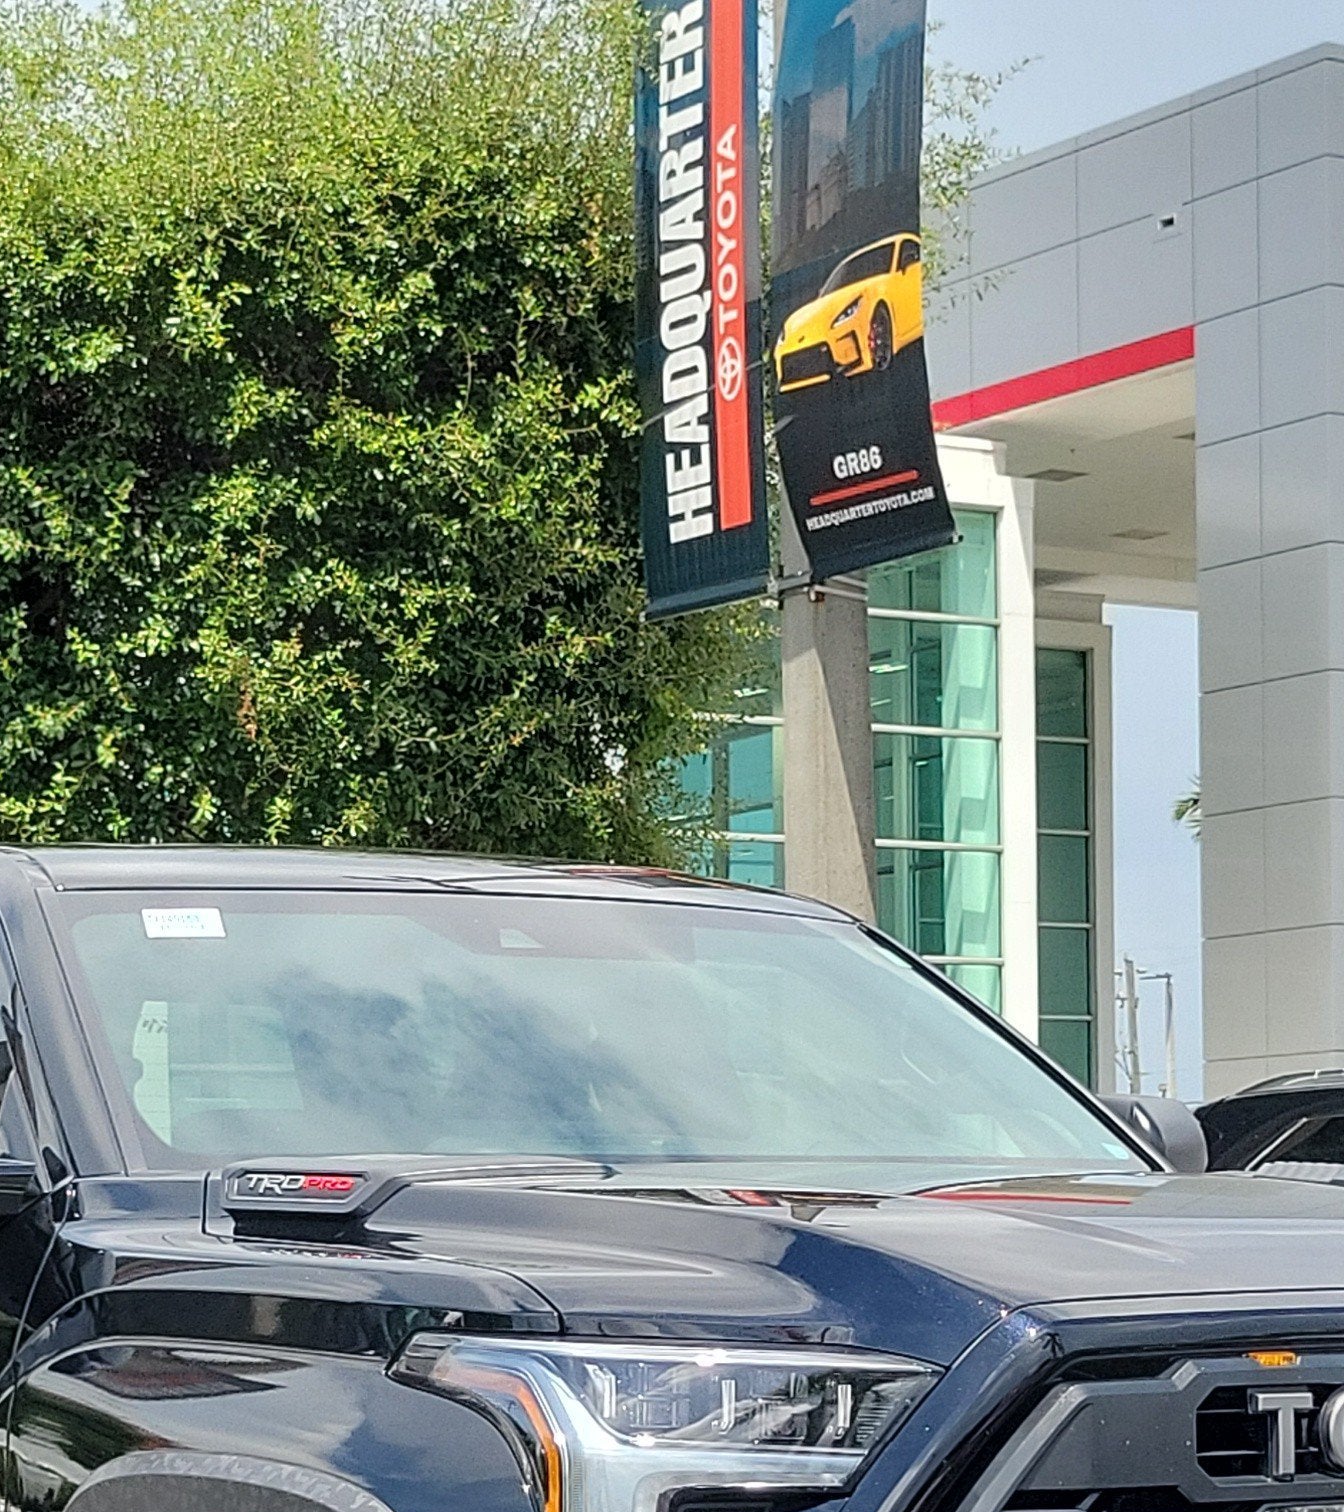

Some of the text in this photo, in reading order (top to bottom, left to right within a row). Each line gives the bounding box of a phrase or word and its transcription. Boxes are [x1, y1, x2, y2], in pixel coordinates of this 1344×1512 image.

[715, 122, 741, 335] TOYOTA
[658, 0, 715, 544] HEADQUARTER
[832, 445, 884, 479] GR86
[805, 485, 936, 532] HEADQUARTERTOYOTA.COM
[243, 1173, 355, 1195] TRD PRO
